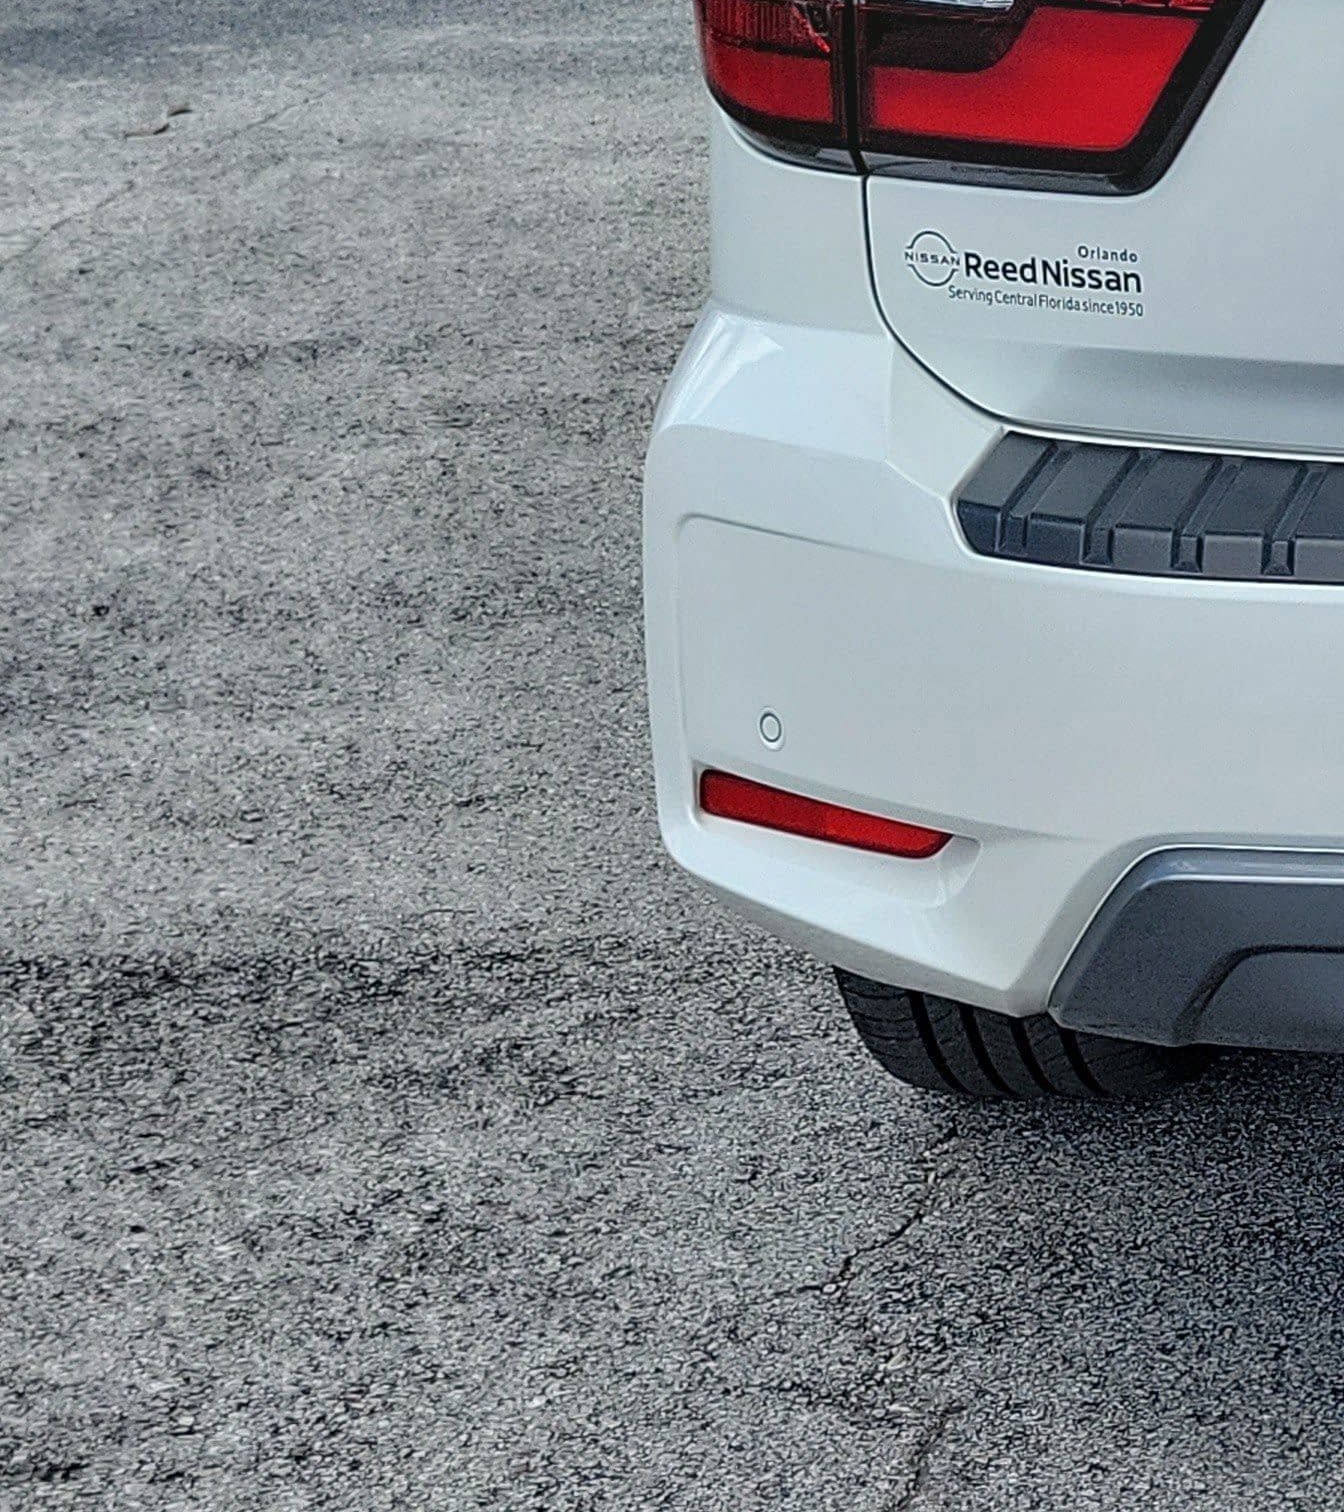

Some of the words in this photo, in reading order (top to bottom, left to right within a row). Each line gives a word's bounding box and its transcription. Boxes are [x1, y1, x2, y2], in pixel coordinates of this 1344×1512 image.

[904, 251, 960, 266] NISSAN
[1076, 245, 1139, 263] Orlando
[949, 285, 993, 306] Serving
[994, 290, 1037, 307] Central
[1038, 293, 1081, 312] Florida
